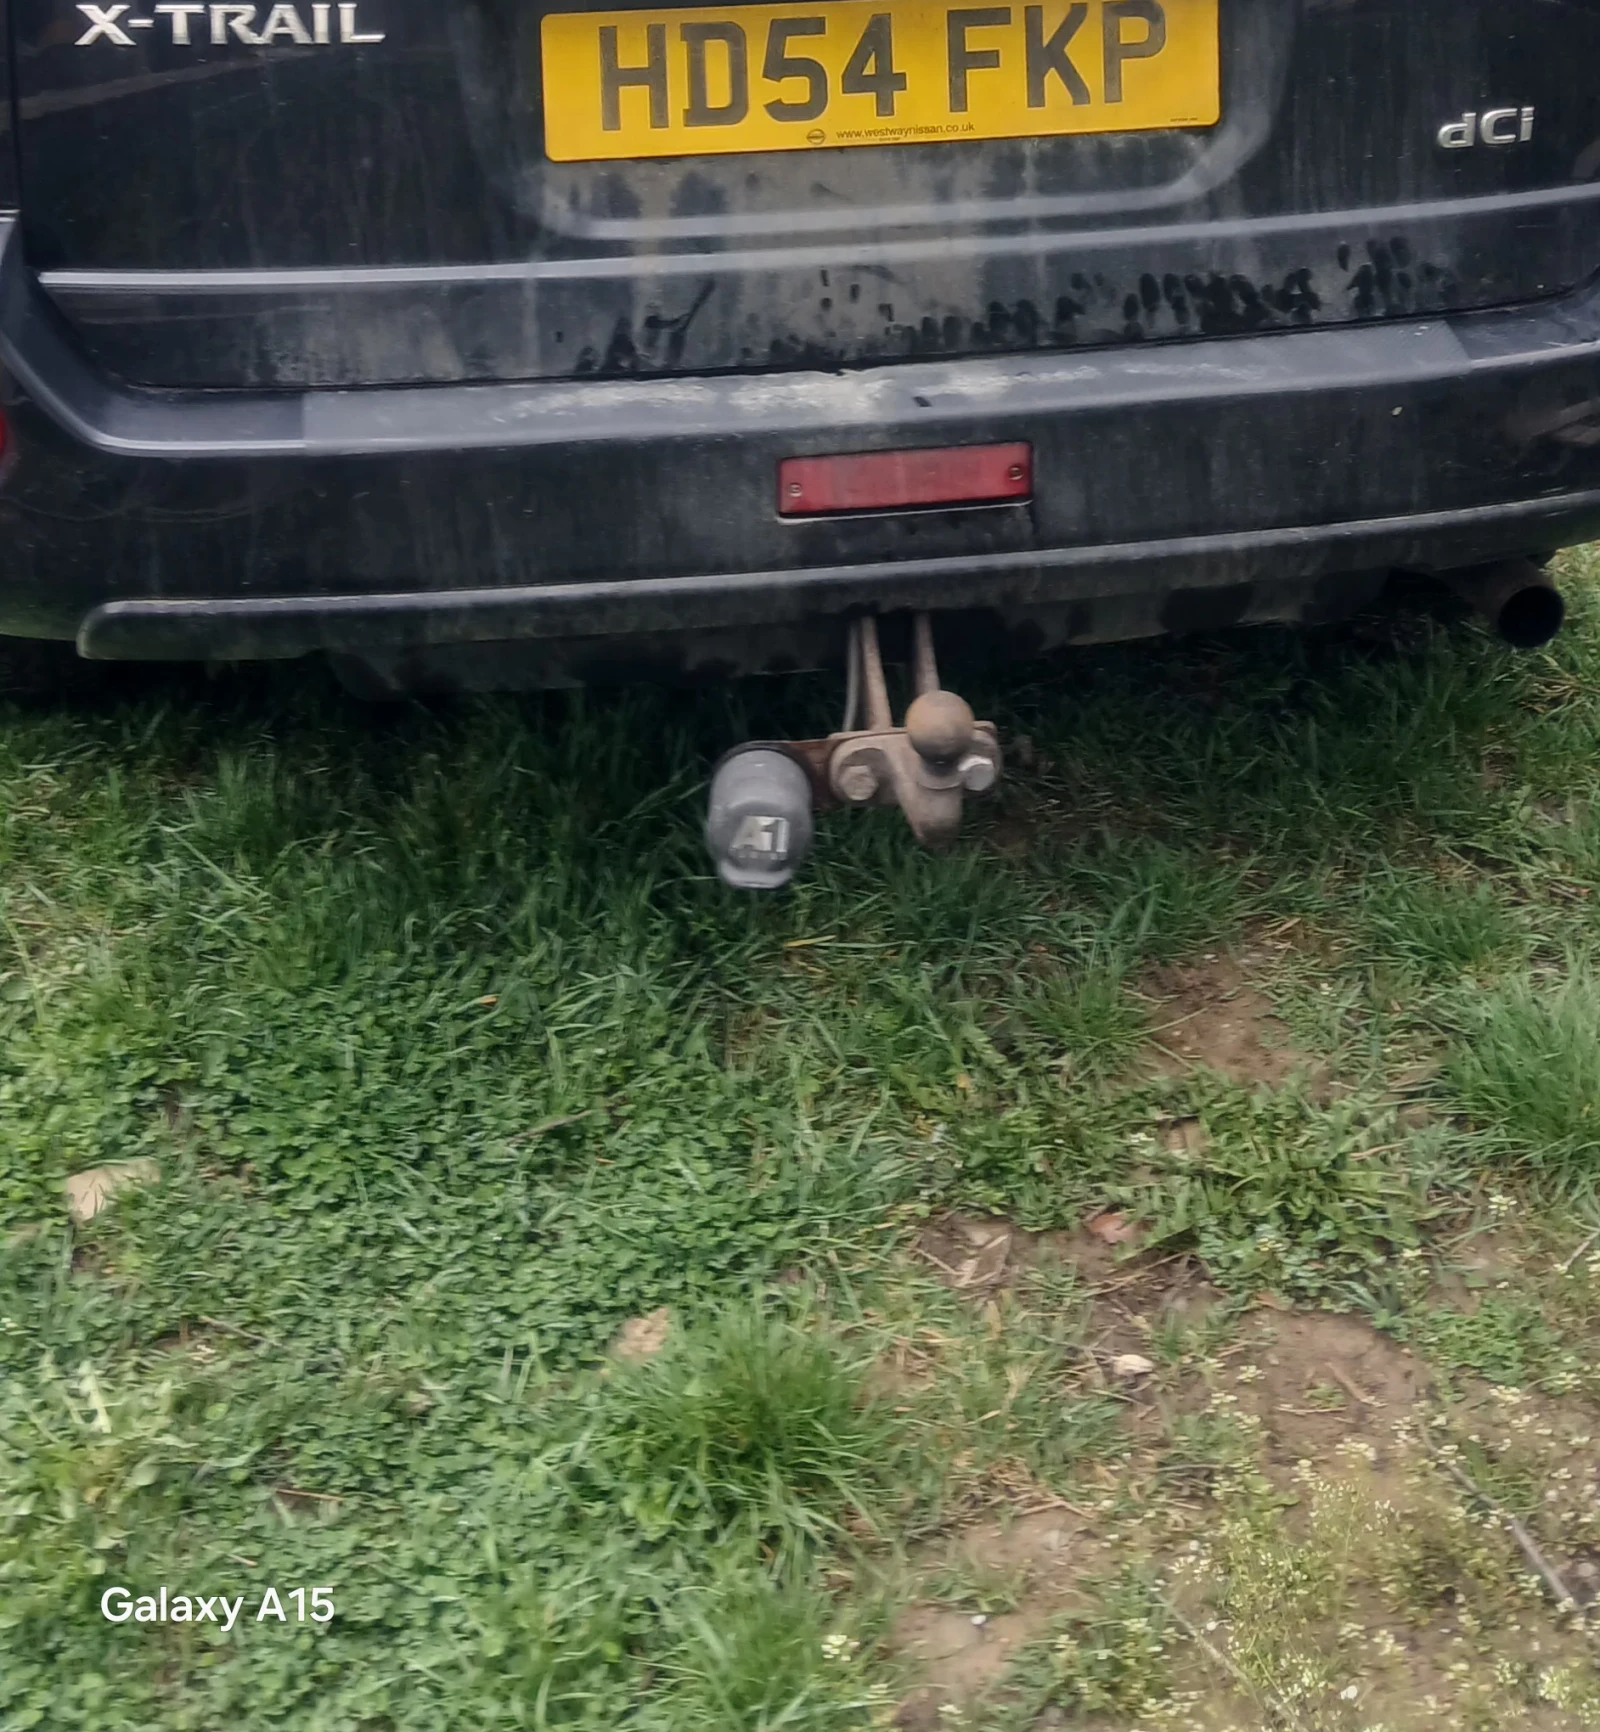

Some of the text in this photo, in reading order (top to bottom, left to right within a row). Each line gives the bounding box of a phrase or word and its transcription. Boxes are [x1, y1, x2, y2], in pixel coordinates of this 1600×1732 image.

[74, 4, 386, 45] X-TRAIL
[600, 1, 1166, 131] HD54 FKP
[836, 122, 975, 139] www.westwaynissan.co.uk
[1437, 107, 1535, 148] dCi
